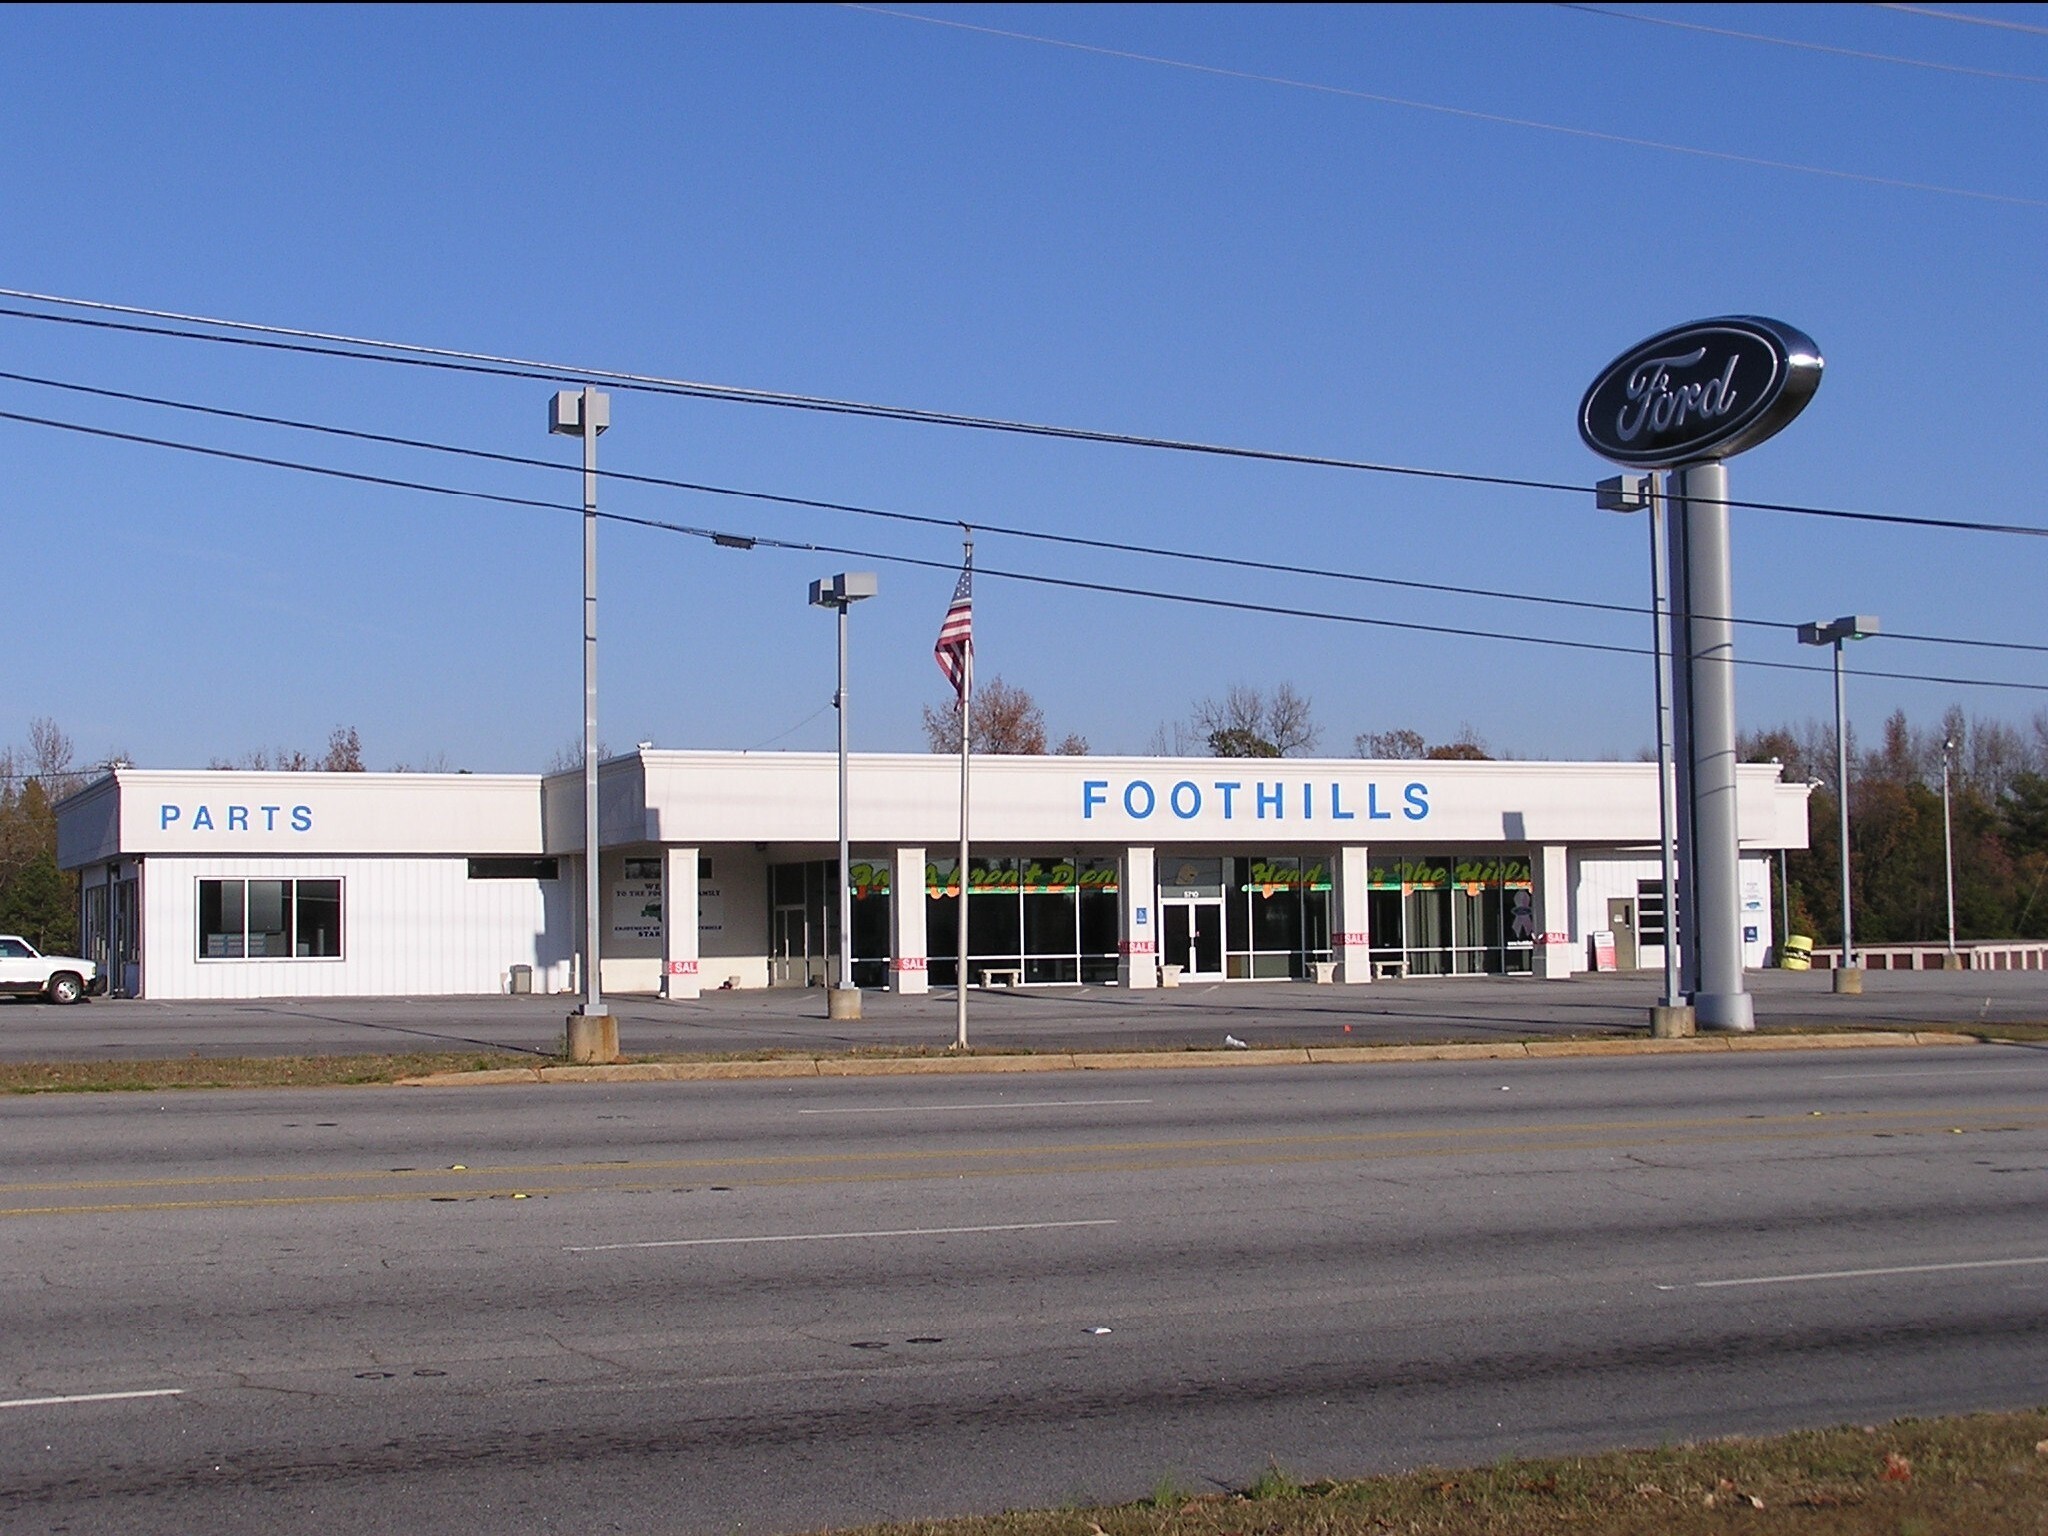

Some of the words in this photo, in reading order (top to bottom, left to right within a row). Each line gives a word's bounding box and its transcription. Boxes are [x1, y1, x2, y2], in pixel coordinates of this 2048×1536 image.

[1616, 346, 1740, 442] Ford
[1083, 780, 1430, 820] FOOTHILLS
[160, 804, 314, 832] PARTS
[1052, 863, 1118, 884] Dea
[1252, 862, 1323, 882] Head
[1394, 861, 1446, 881] The
[1130, 941, 1155, 952] SALE
[675, 961, 698, 973] SAL
